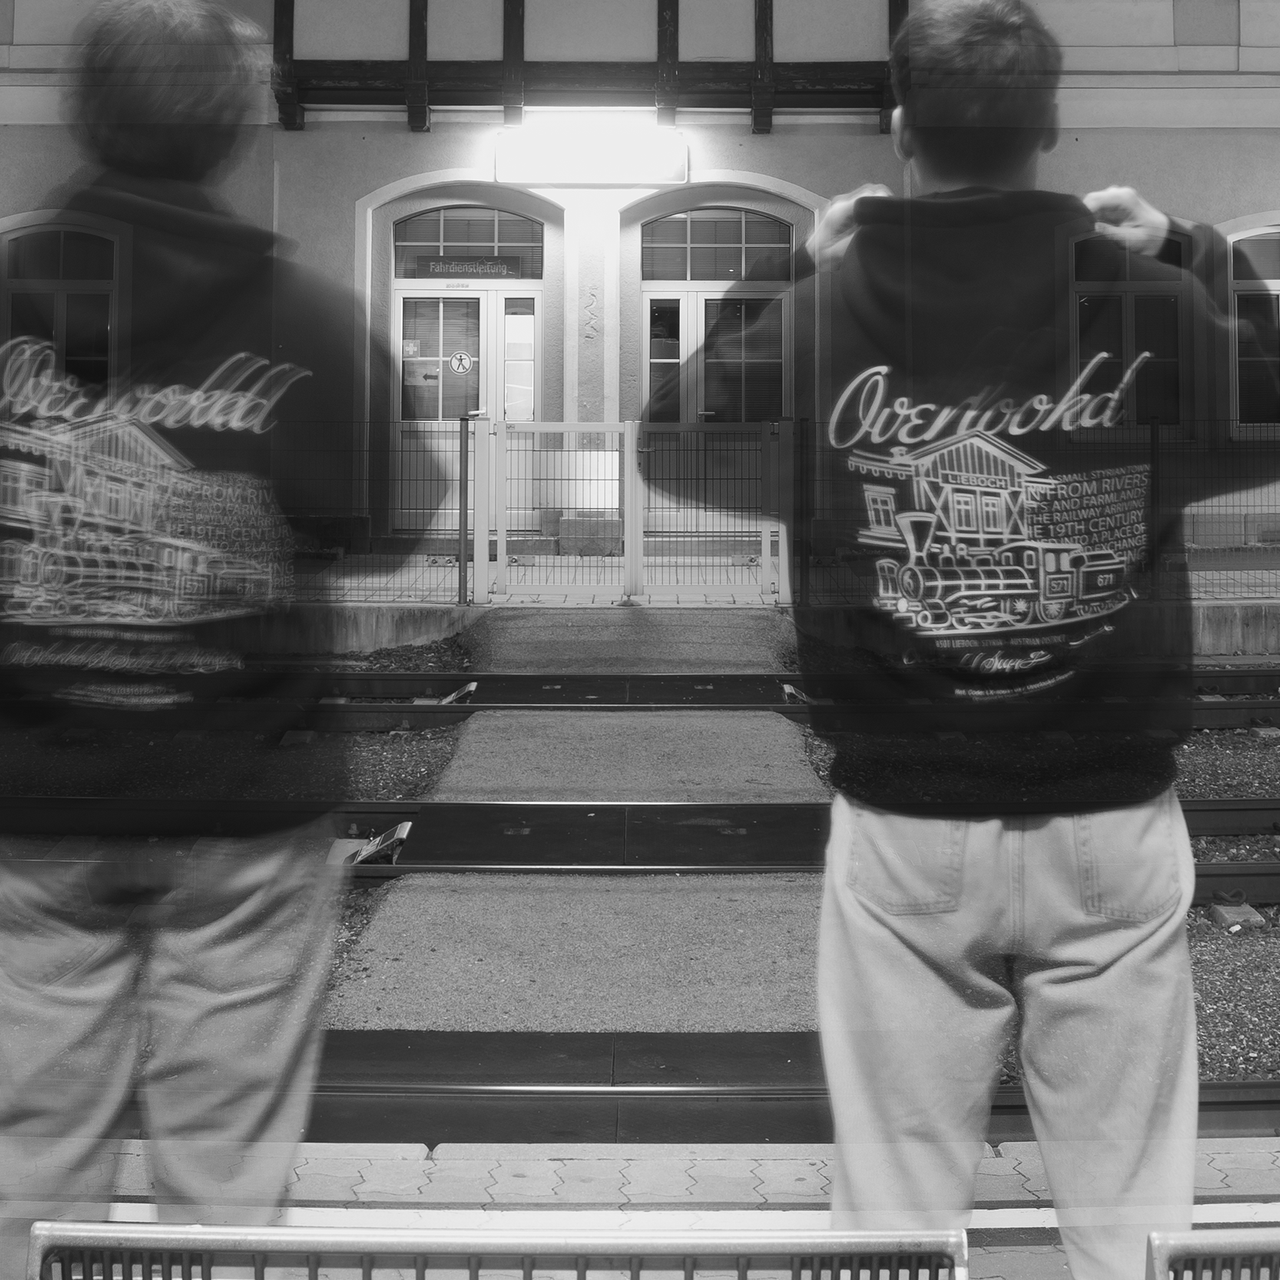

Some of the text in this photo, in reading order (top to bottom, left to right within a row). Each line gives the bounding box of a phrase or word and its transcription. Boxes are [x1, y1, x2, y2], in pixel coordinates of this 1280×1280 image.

[429, 261, 507, 275] Fahrdienstleitung
[948, 474, 1006, 488] LIEBOCH
[1046, 480, 1098, 500] FROM
[1102, 473, 1149, 493] RIVERS
[1052, 498, 1081, 511] AND
[1083, 487, 1147, 507] FARMLANDS
[1053, 507, 1102, 522] RAILWAY
[1105, 498, 1145, 515] ARRIVING
[1048, 521, 1085, 537] 19TH
[1089, 508, 1144, 532] CENTURY
[1101, 525, 1132, 541] PLACE
